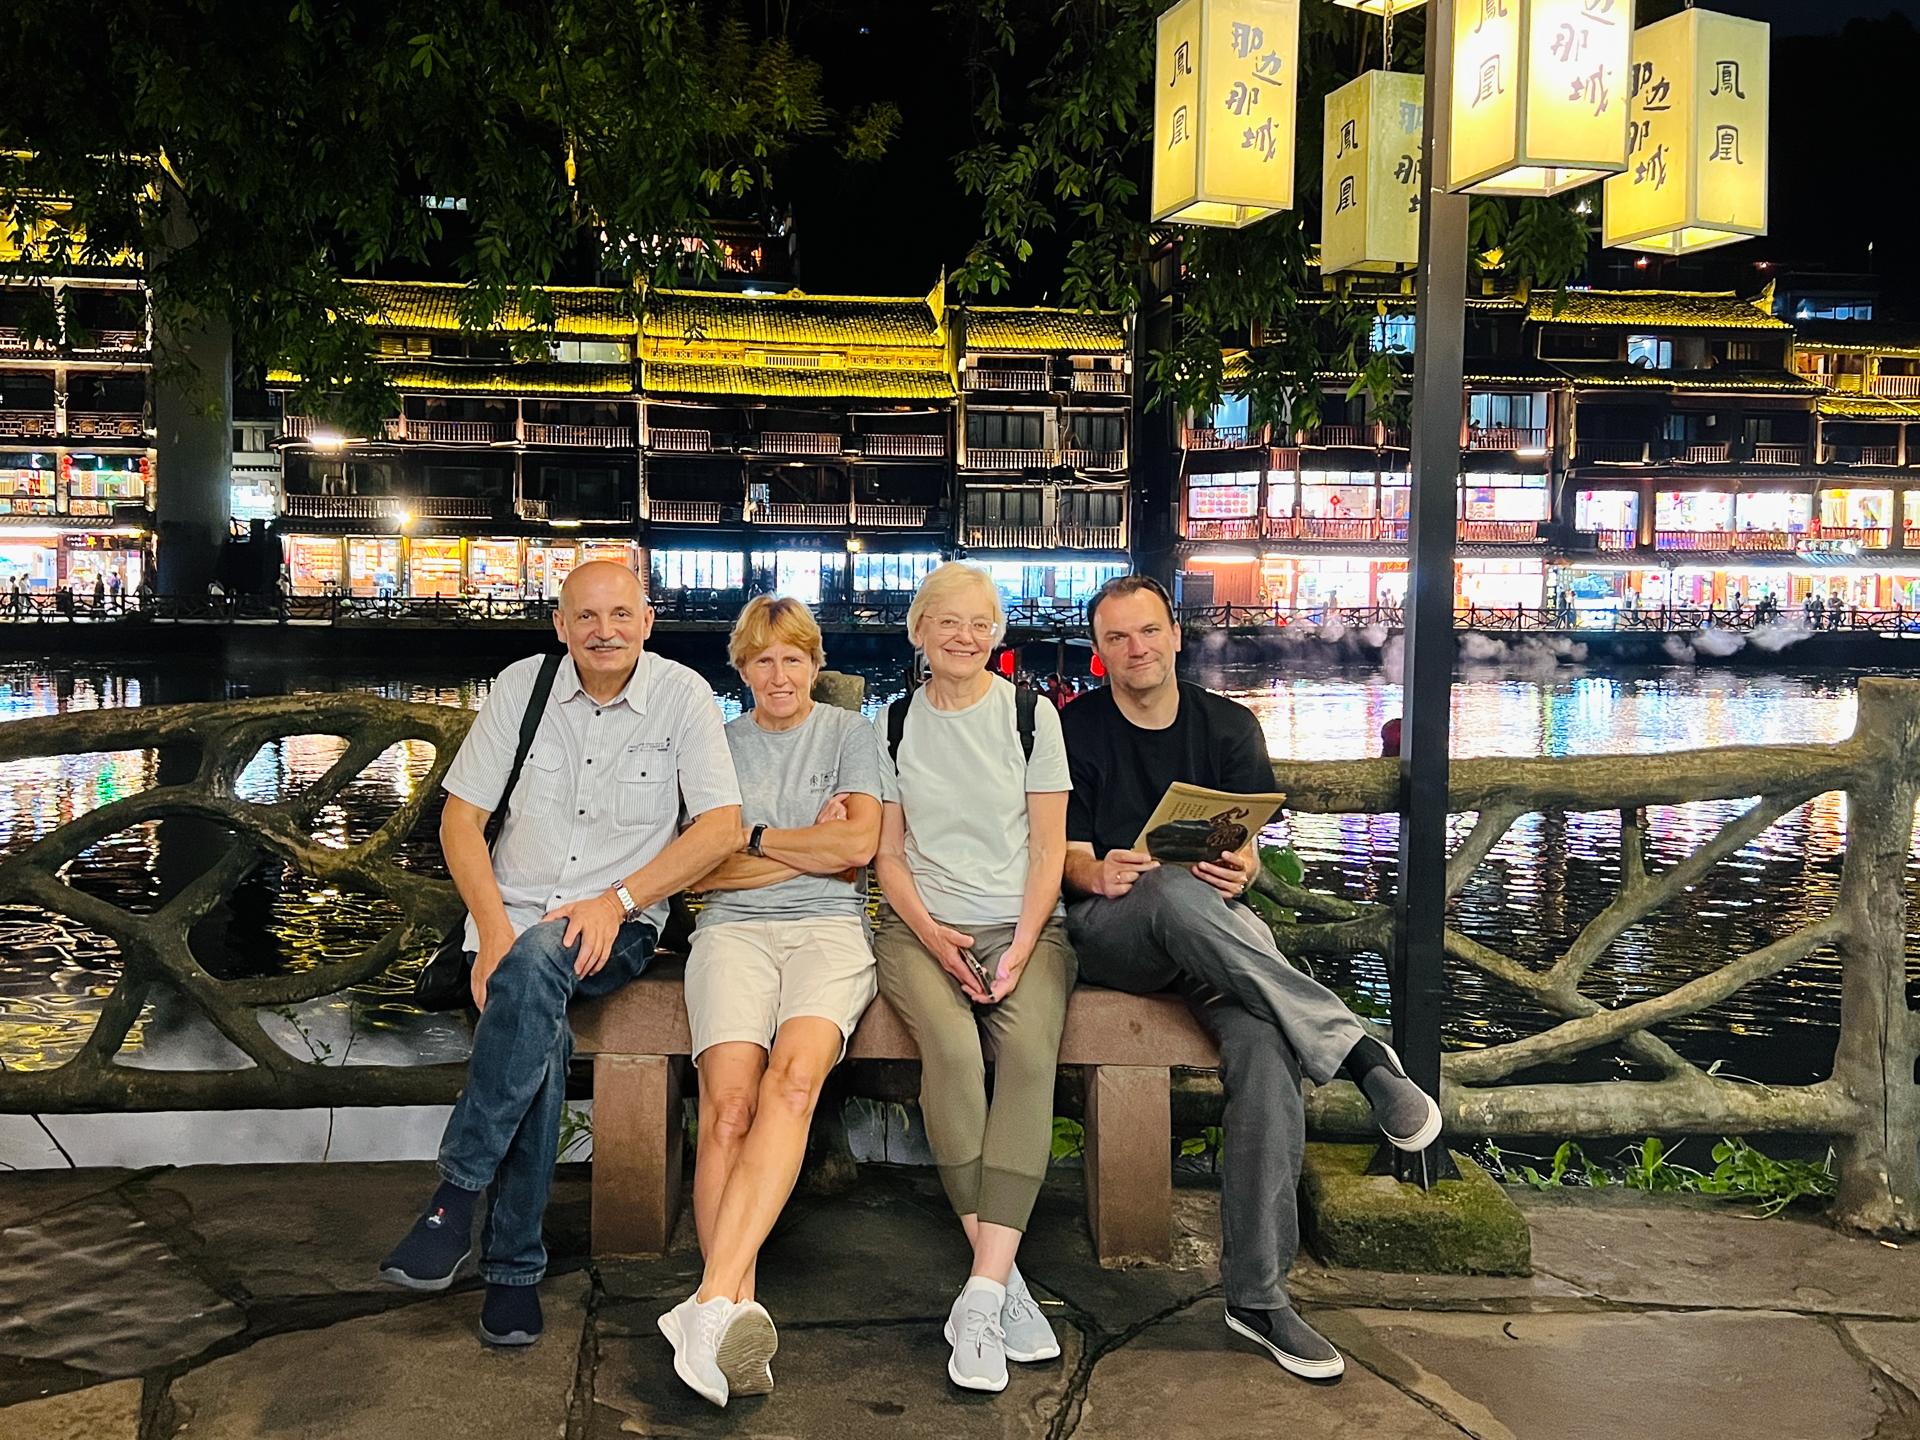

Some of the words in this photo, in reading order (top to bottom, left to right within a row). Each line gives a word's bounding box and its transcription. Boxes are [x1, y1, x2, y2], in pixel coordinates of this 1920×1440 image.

[1168, 41, 1192, 152] 鳳凰
[1709, 61, 1746, 165] 鳳凰
[1335, 119, 1359, 216] 鳳凰
